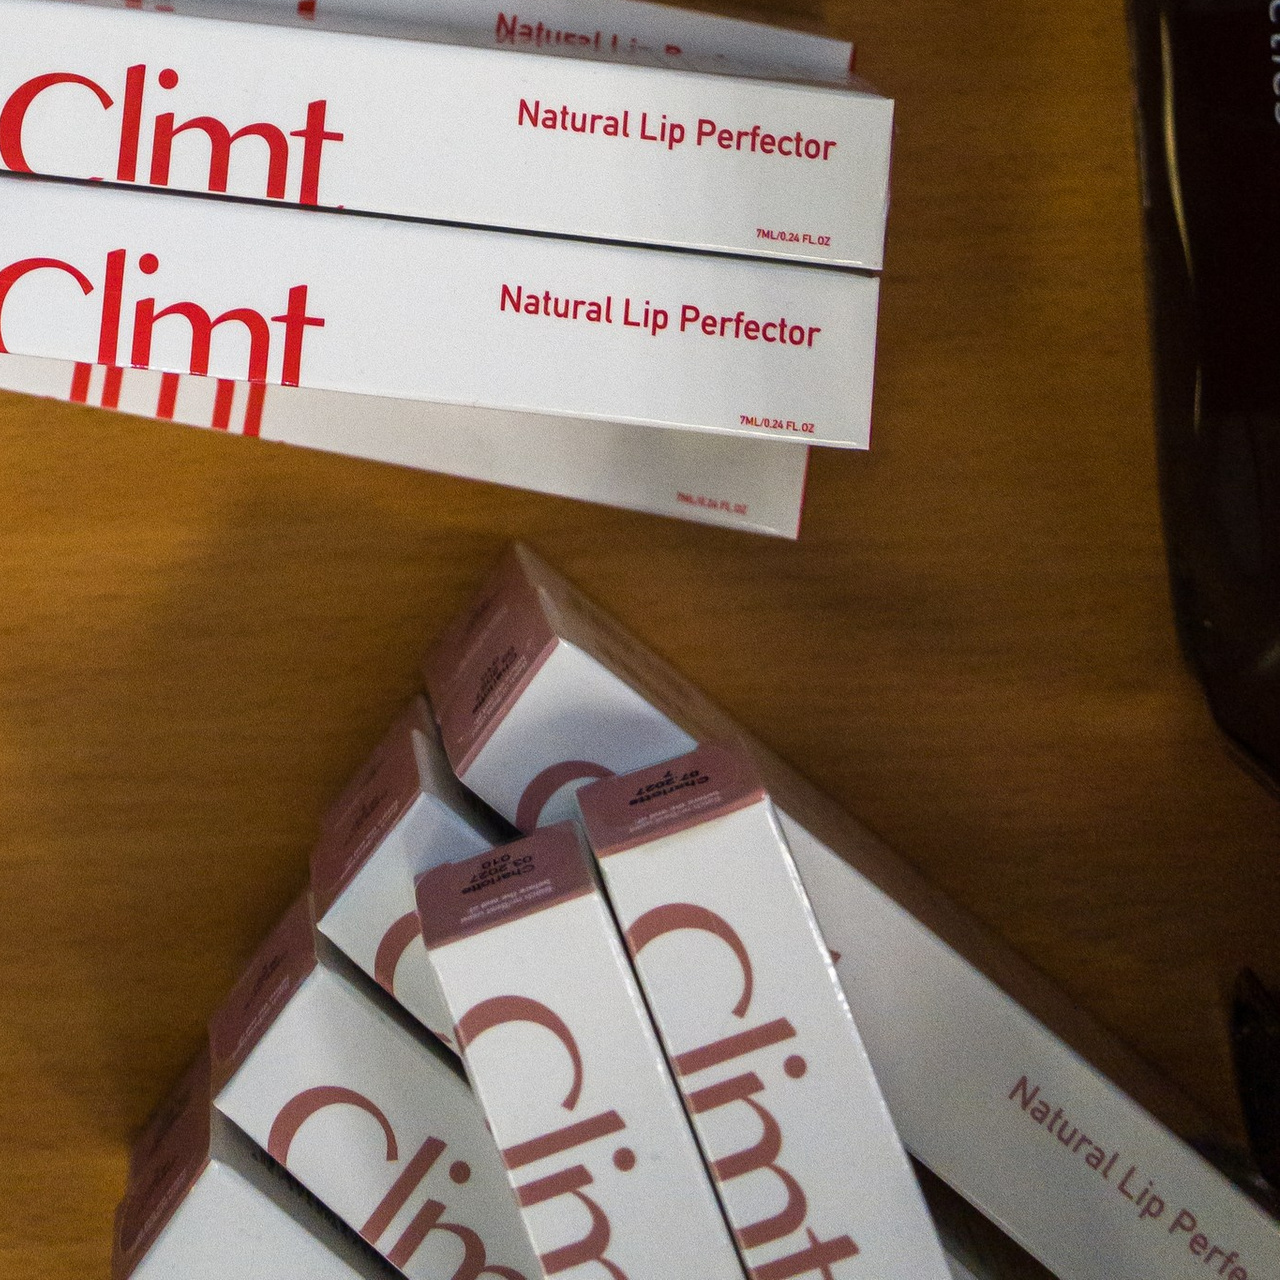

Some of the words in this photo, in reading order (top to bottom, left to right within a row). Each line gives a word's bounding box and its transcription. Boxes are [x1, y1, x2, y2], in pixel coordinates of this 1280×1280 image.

[518, 98, 630, 139] Natural
[640, 111, 686, 150] Lip
[696, 117, 838, 161] Perfector
[755, 227, 800, 244] 7ML/0.24
[499, 284, 613, 323] Natural
[622, 297, 669, 337] Lip
[679, 305, 821, 348] Perfector
[739, 414, 784, 431] 7ML/0.24
[628, 775, 710, 807] Charlotte
[470, 854, 532, 884] 03.2027
[481, 853, 511, 870] 010
[461, 864, 536, 895] Charlotte
[1007, 1074, 1120, 1181] Natural
[1118, 1164, 1166, 1221] Lip
